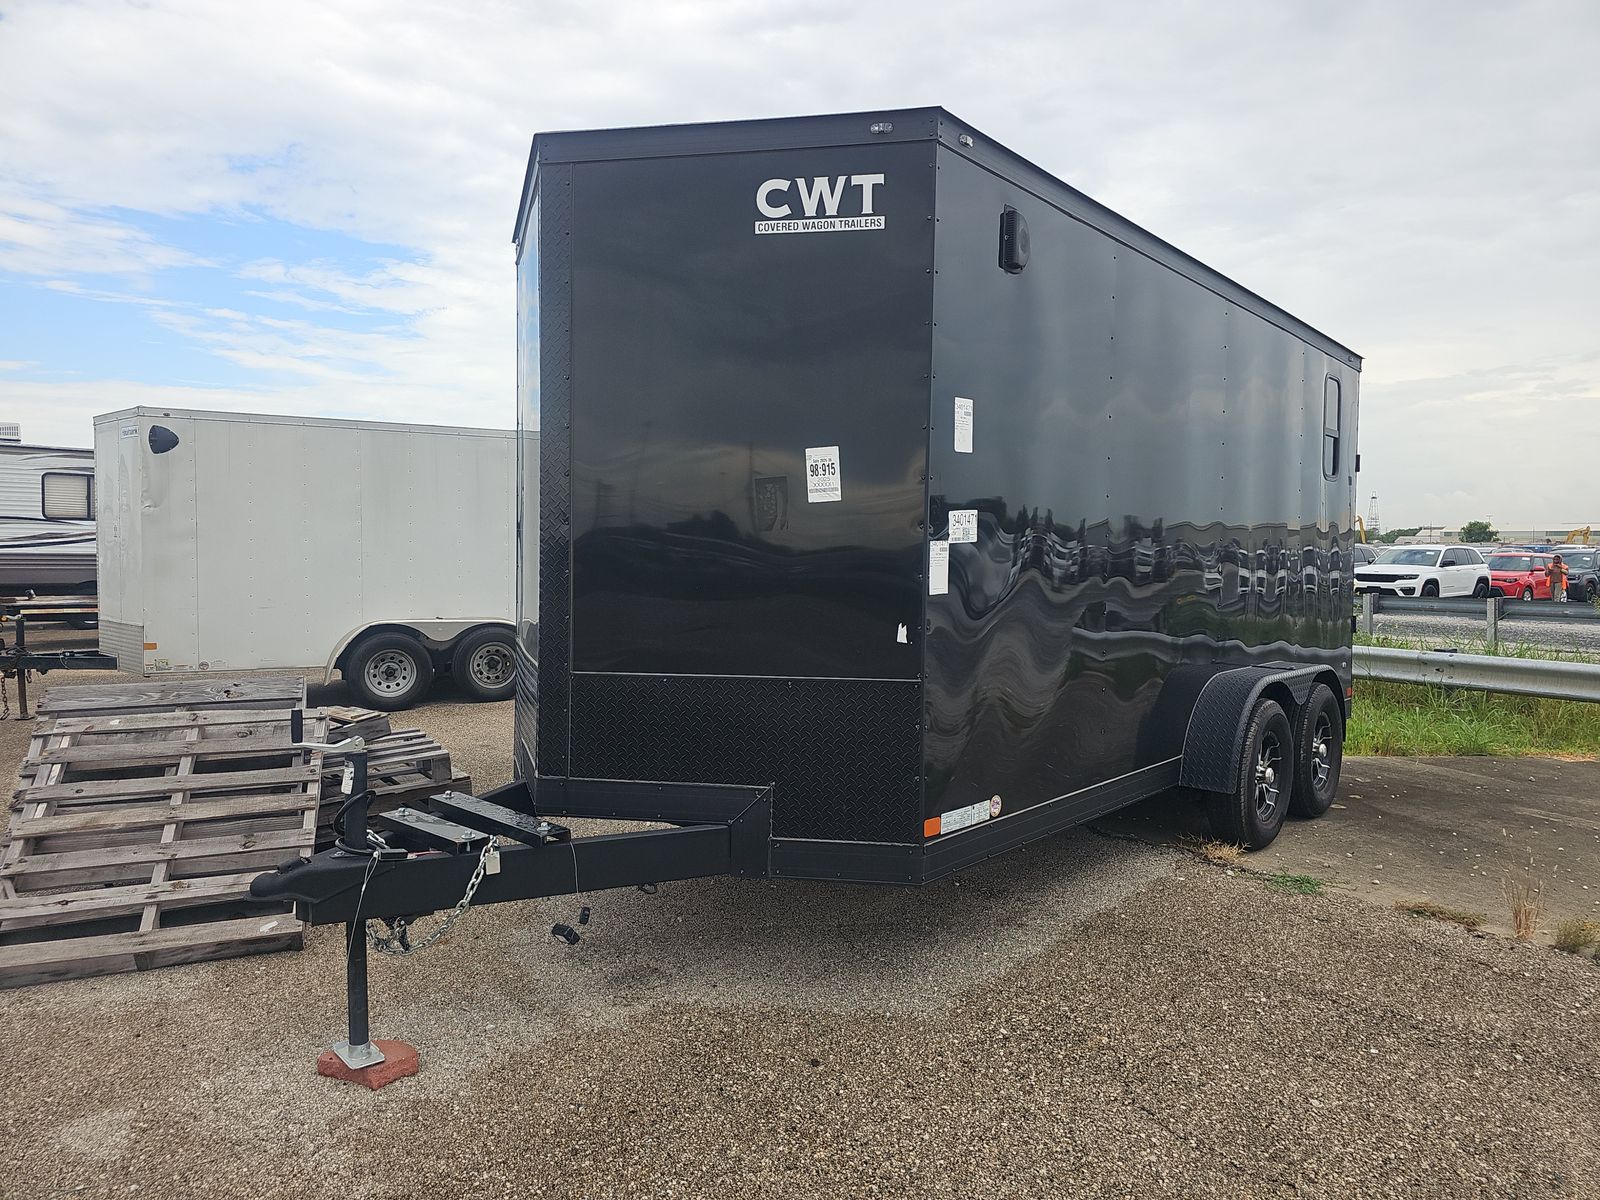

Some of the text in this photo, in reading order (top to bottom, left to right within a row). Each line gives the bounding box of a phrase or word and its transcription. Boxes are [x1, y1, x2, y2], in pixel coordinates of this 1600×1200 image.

[756, 173, 885, 218] CWT
[757, 218, 882, 232] COVERED WAGON TRAILERS
[809, 462, 836, 477] 98:915
